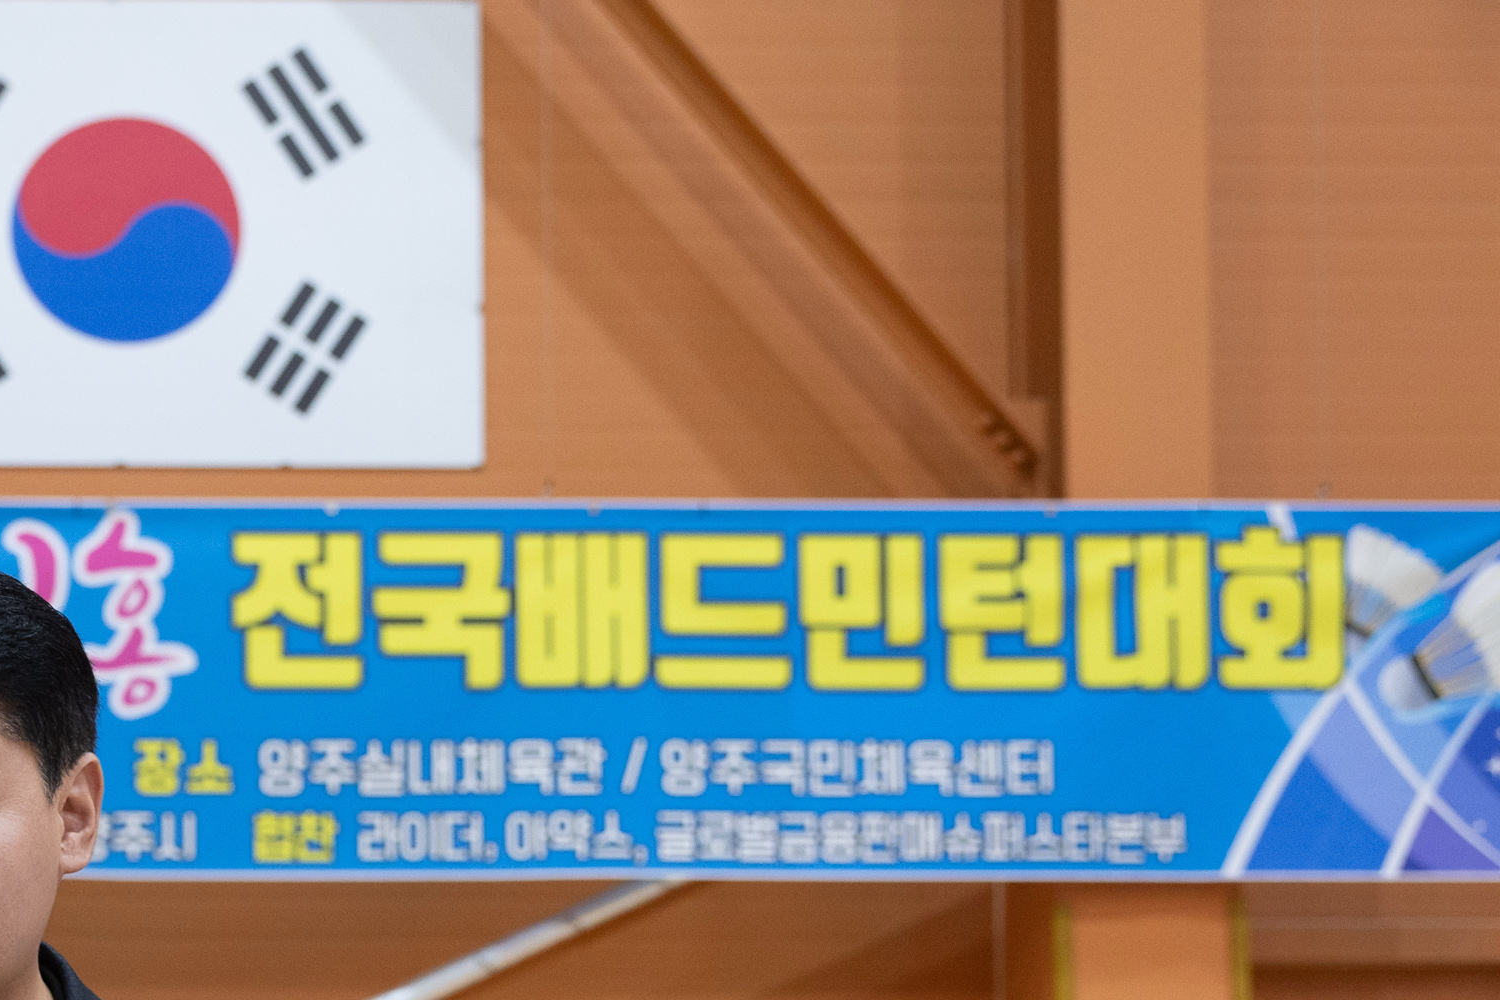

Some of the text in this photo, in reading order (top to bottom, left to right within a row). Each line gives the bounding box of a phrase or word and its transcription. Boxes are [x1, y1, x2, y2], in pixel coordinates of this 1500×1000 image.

[231, 525, 1347, 691] 전국배드민턴대회
[134, 738, 234, 797] 장소
[258, 737, 607, 798] 양주실내체육관
[660, 737, 1055, 798] 양주국민체육센터
[253, 810, 340, 864] 협찬
